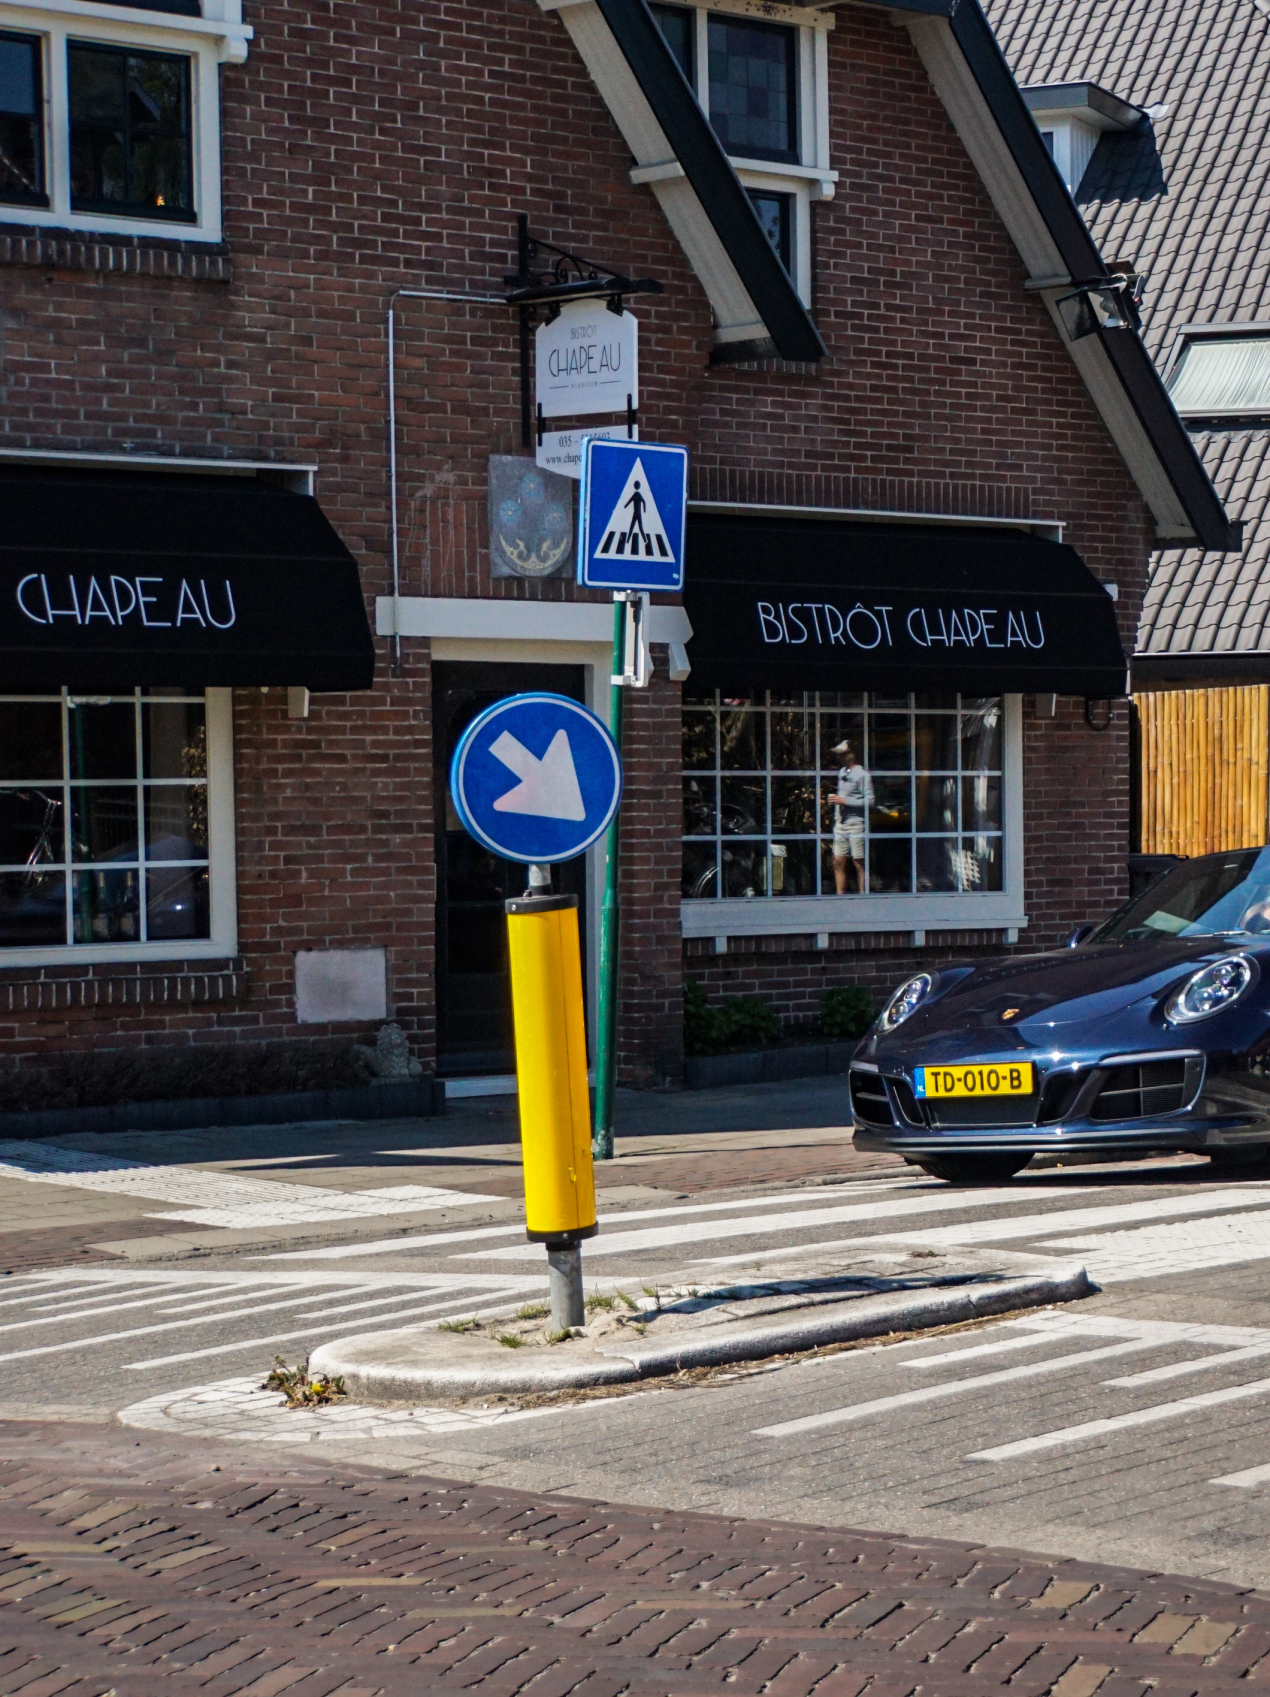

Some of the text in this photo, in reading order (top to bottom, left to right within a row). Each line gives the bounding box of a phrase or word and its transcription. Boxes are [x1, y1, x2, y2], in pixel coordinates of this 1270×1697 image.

[548, 342, 621, 377] CHAPEAU
[558, 435, 572, 448] 035
[16, 573, 236, 628] CHAPEAU
[757, 602, 1045, 649] BISTRÔT CHAPEAU
[930, 1068, 1022, 1093] TD-010-B
